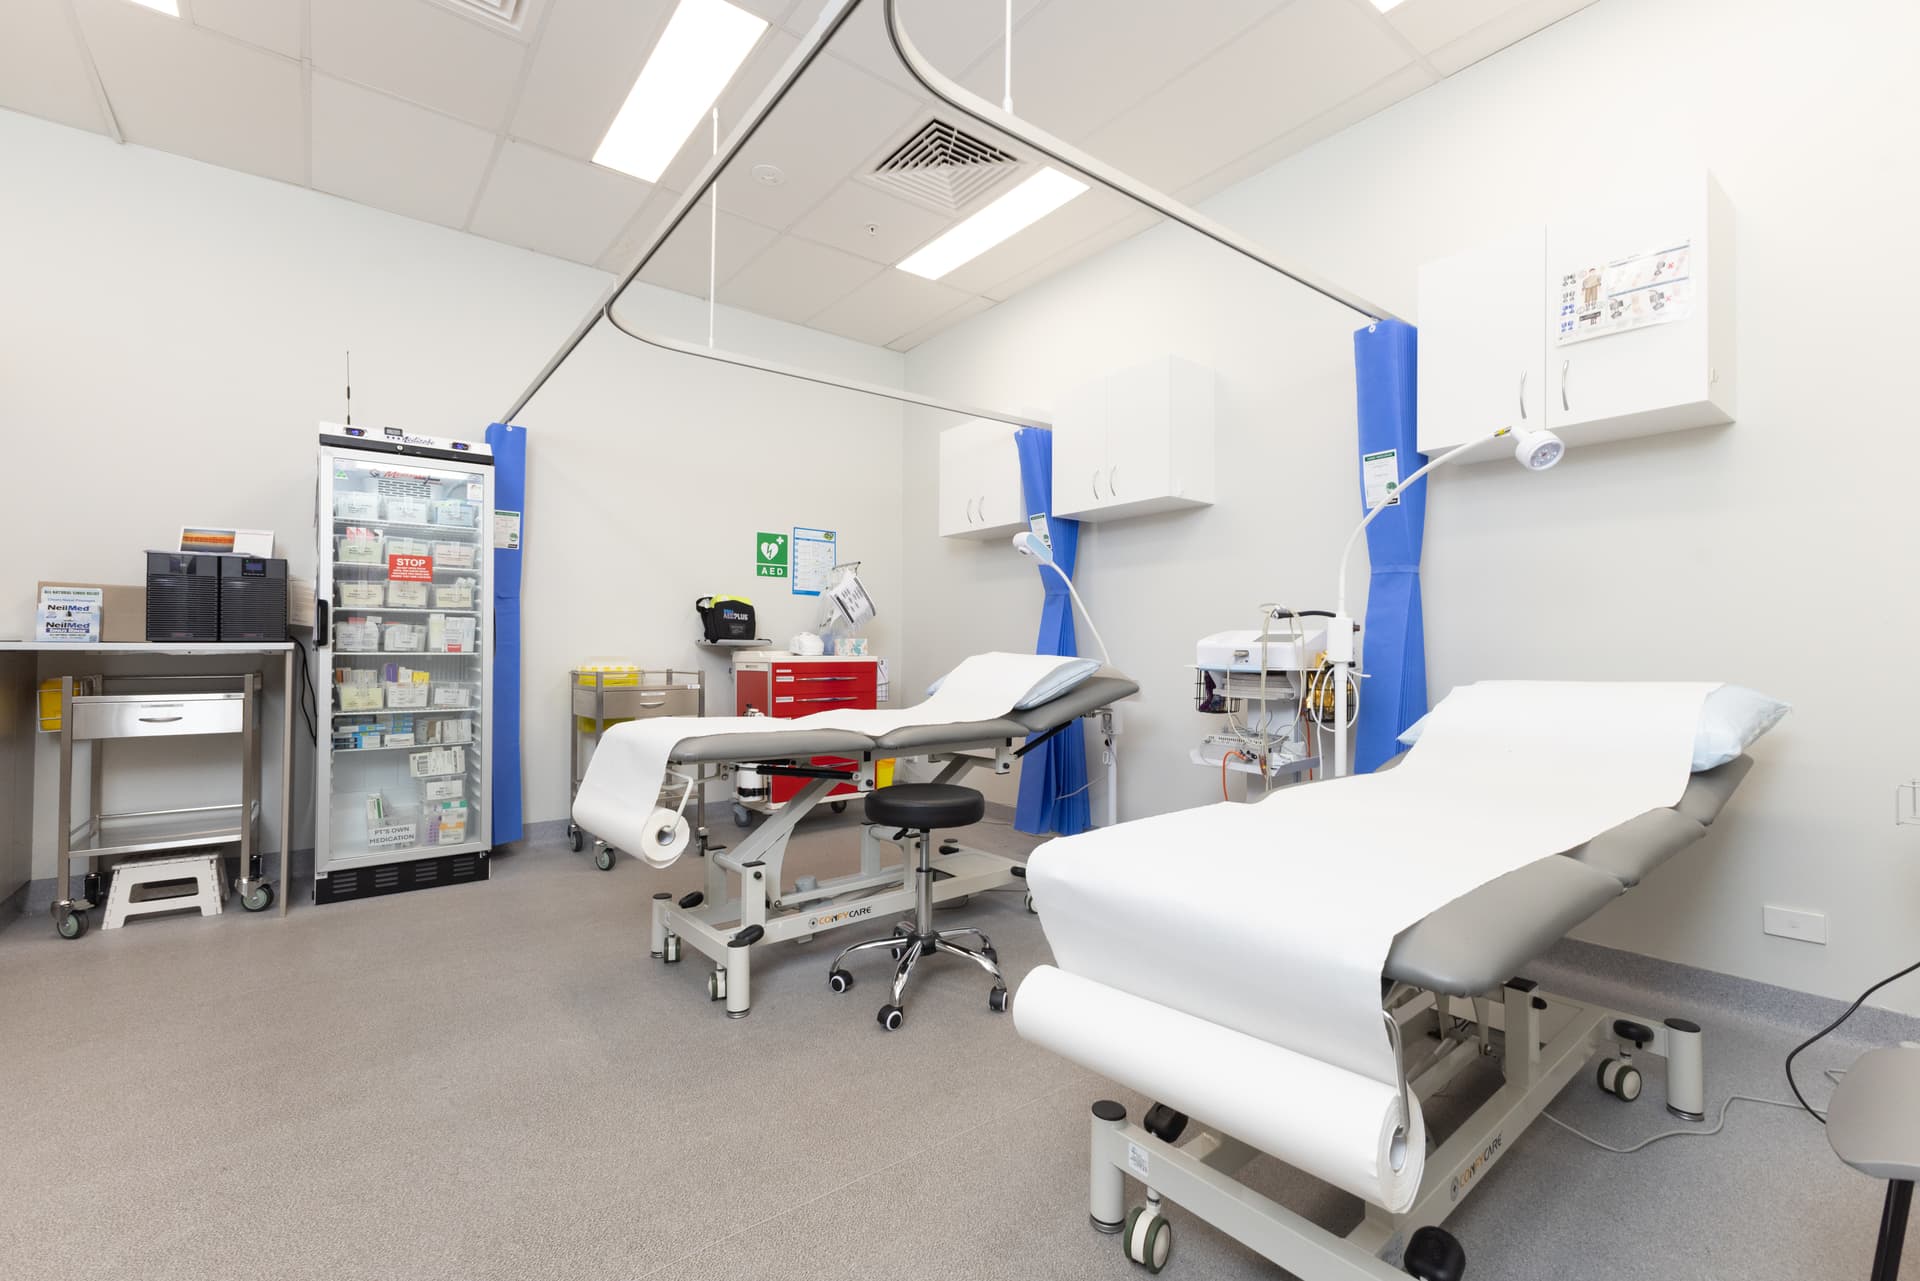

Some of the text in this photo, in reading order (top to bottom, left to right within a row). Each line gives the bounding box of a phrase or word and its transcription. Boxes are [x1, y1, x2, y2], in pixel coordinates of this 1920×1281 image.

[396, 558, 427, 567] STOP
[761, 567, 784, 576] AED
[369, 834, 415, 844] MEDICATION
